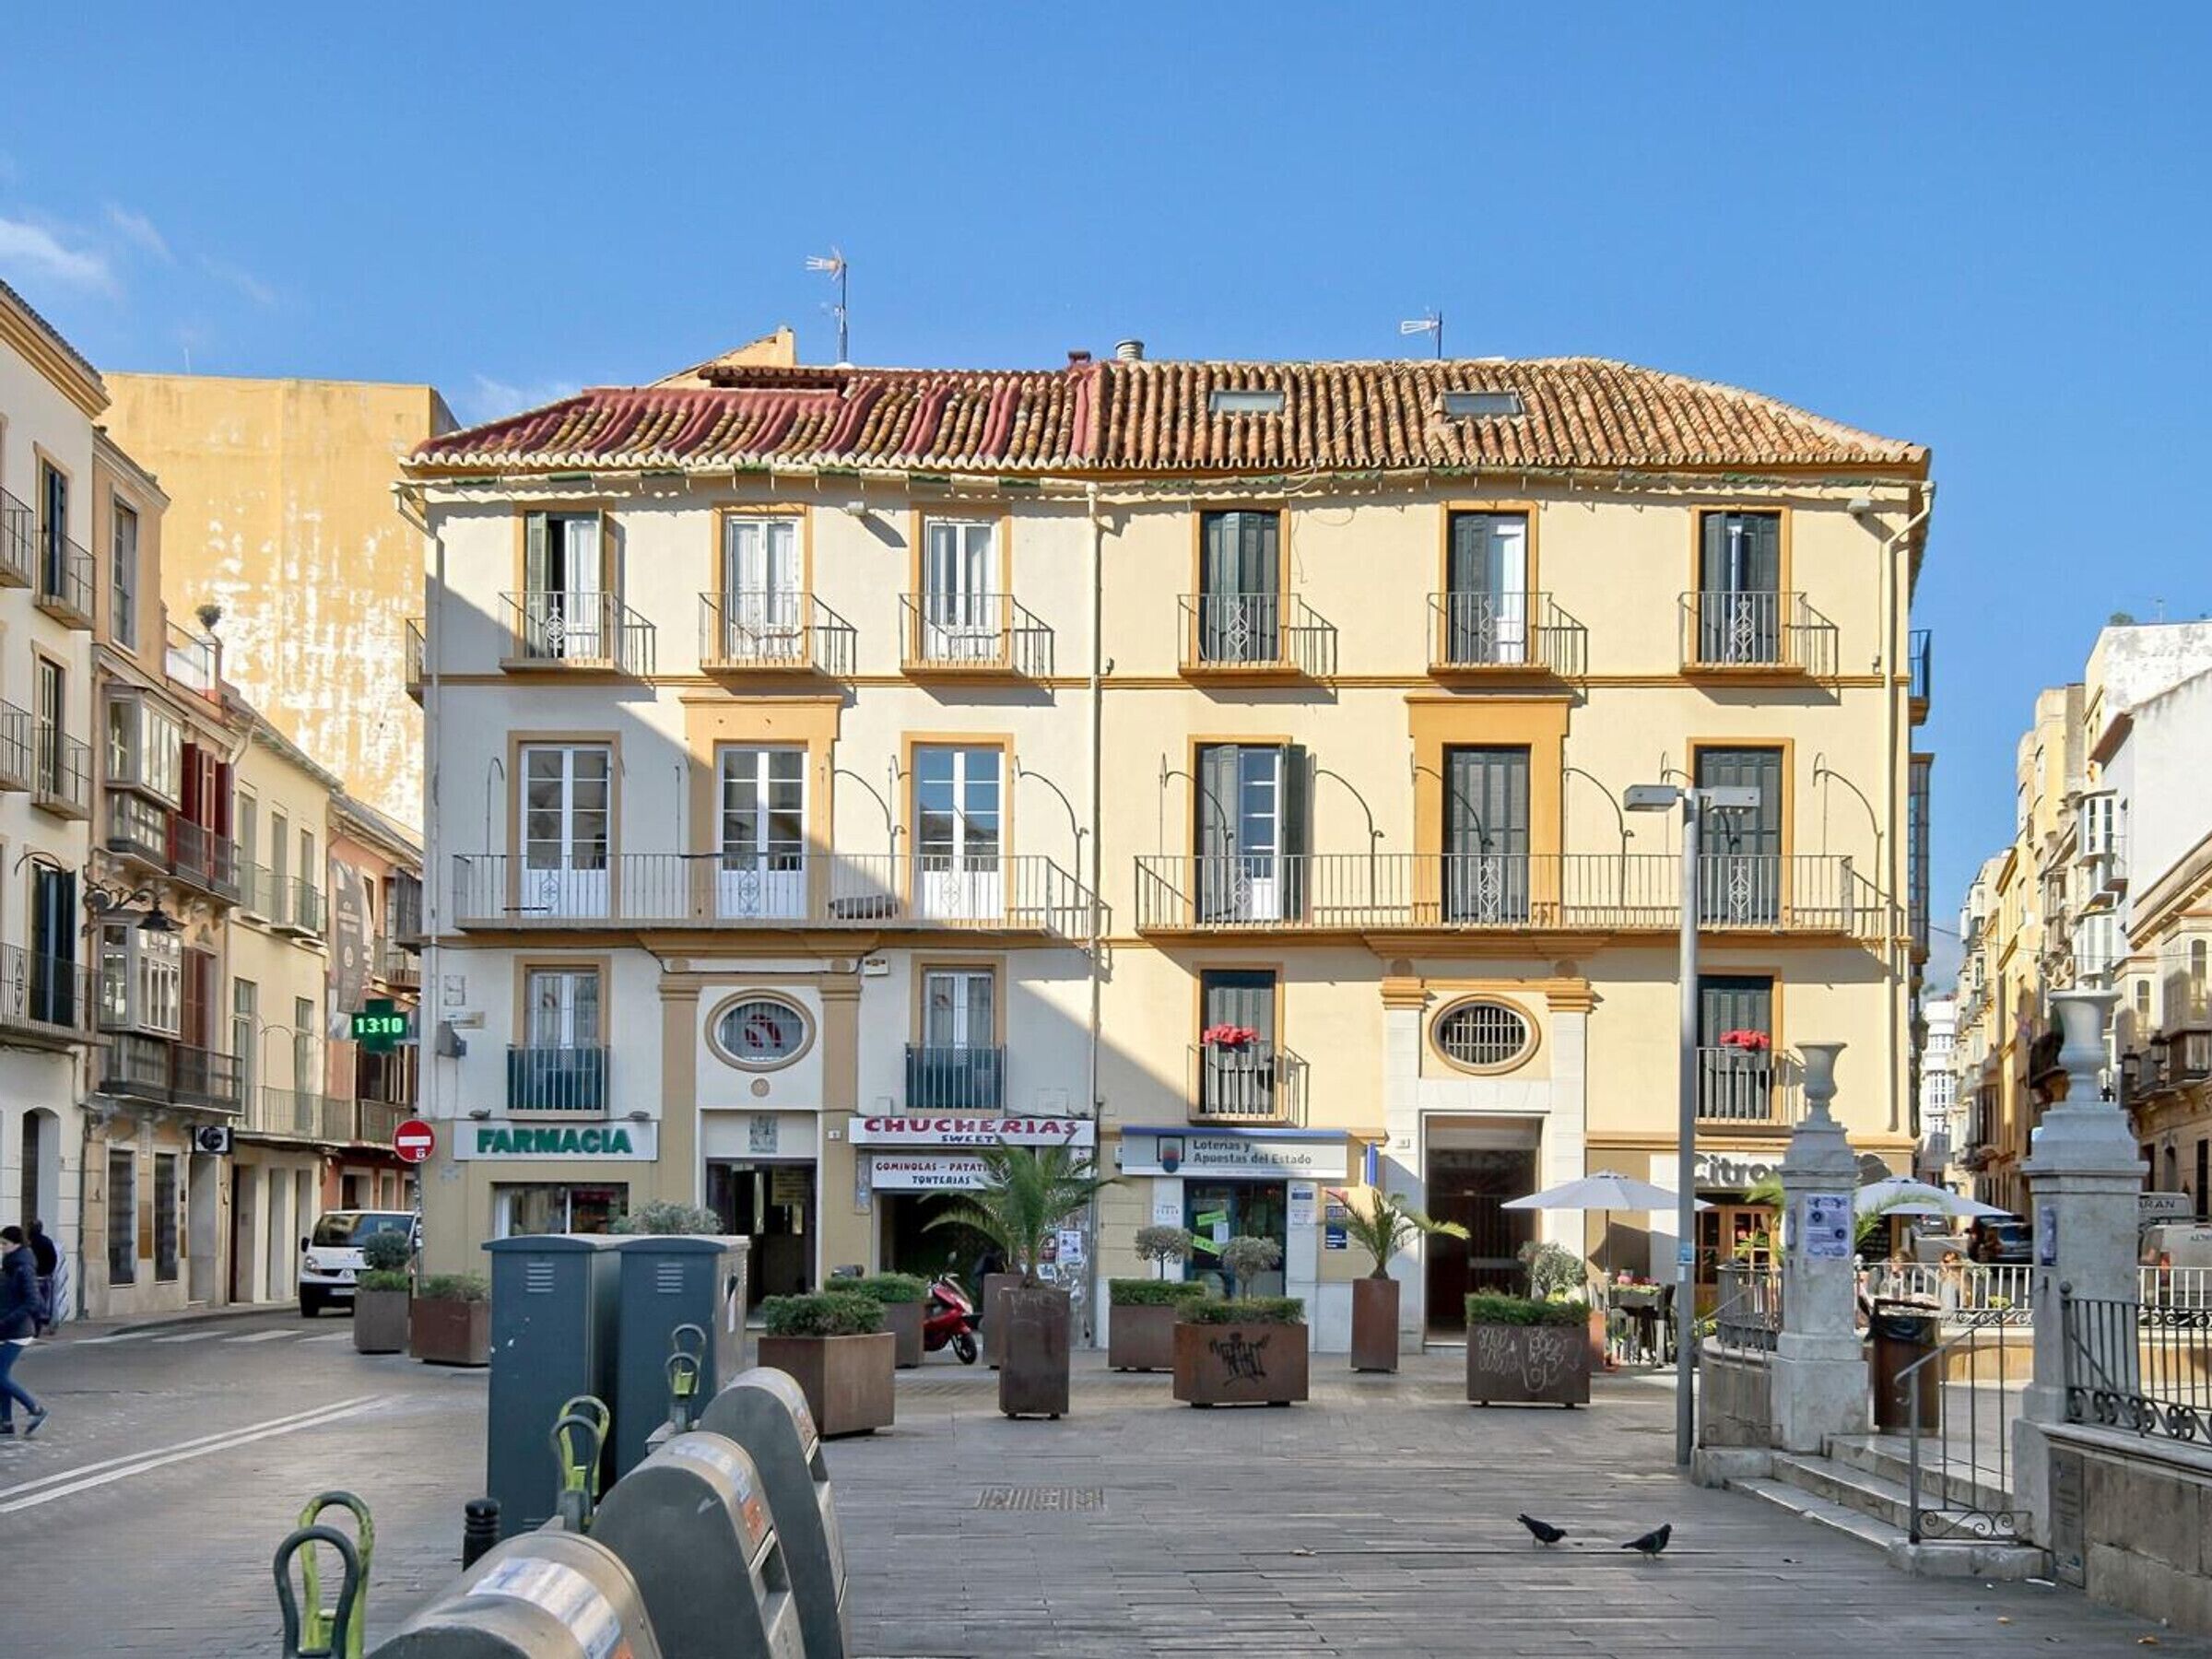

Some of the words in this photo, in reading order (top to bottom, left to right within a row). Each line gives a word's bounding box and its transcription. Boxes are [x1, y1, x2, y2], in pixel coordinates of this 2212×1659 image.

[864, 1118, 1077, 1135] CHUCHERIAS
[477, 1128, 633, 1153] FARMACIA
[1194, 1153, 1248, 1165] Apuestas
[1251, 1153, 1269, 1164] del
[1272, 1154, 1312, 1165] Estado
[1694, 1153, 1780, 1187] Citro
